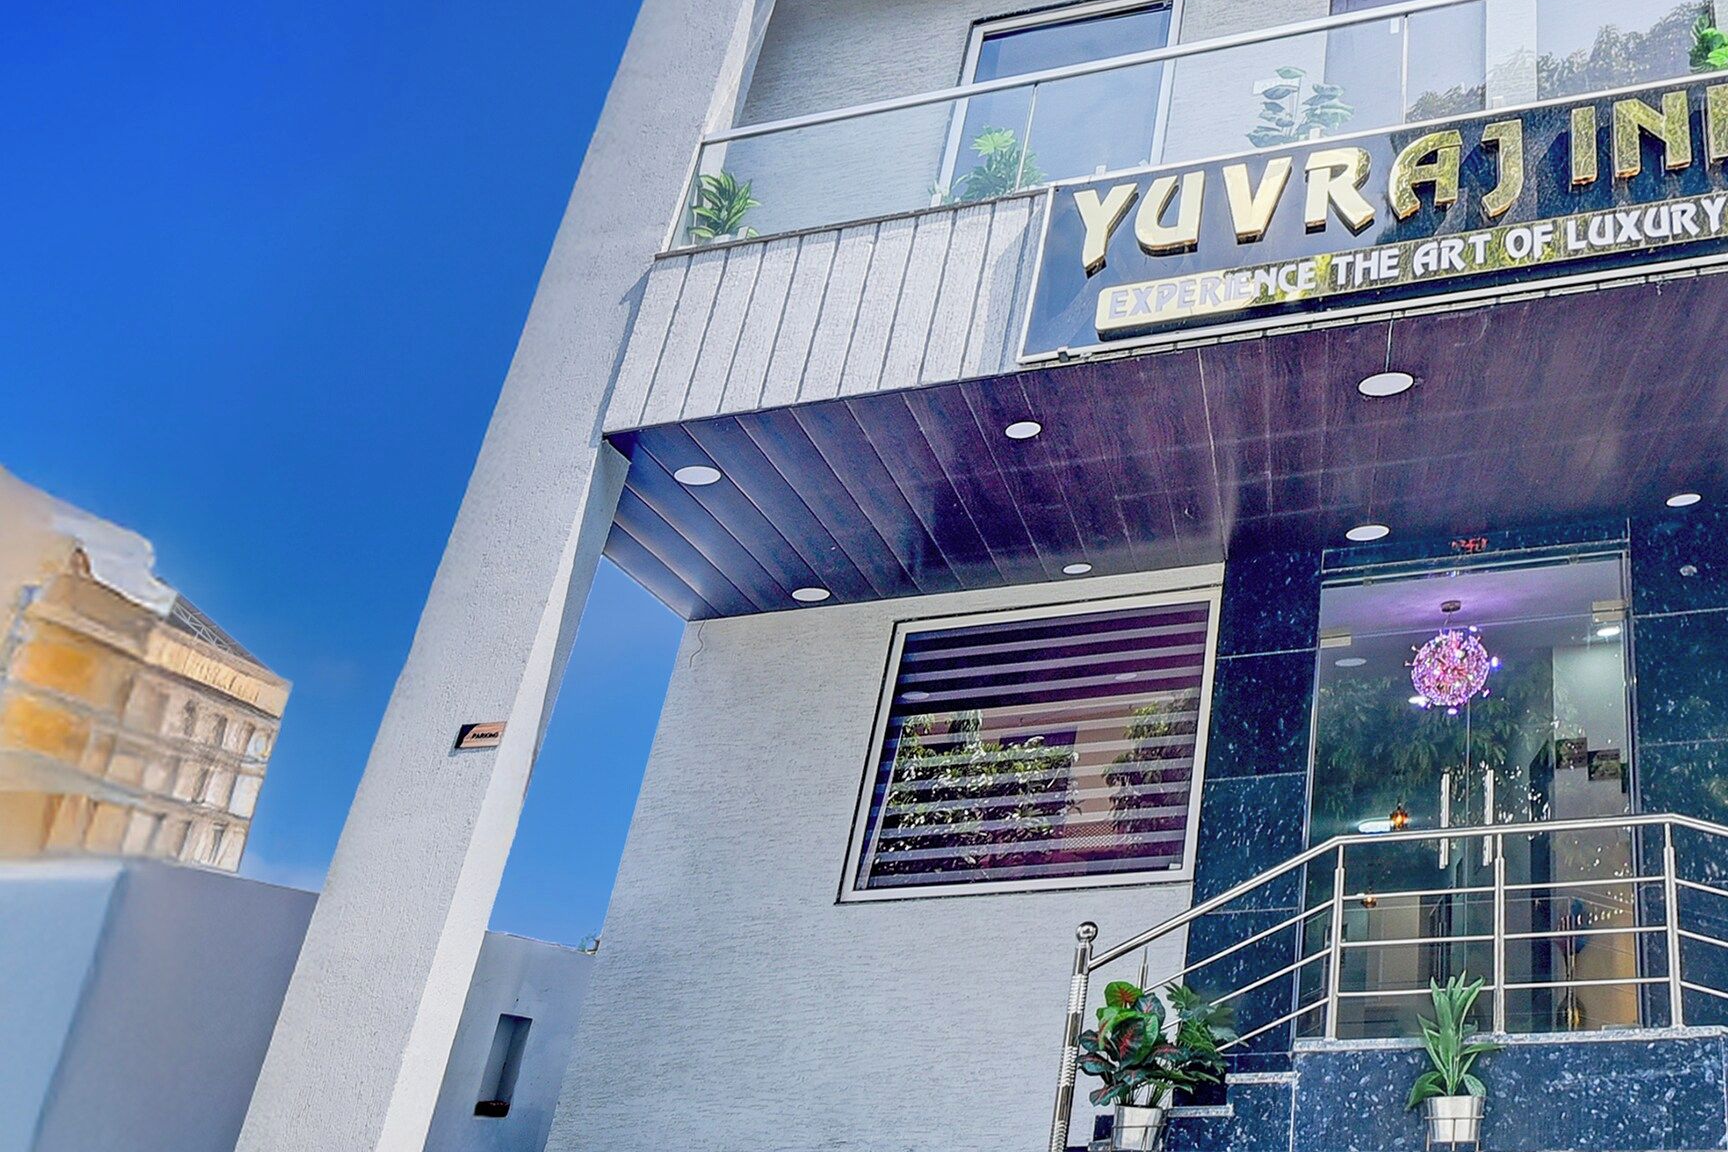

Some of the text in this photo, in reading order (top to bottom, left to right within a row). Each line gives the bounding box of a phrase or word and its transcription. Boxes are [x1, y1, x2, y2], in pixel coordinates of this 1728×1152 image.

[1073, 119, 1524, 279] YUVRAJ
[1107, 196, 1727, 320] EXPERIENCE THE ART OF LUXURY
[471, 731, 499, 739] PARKING
